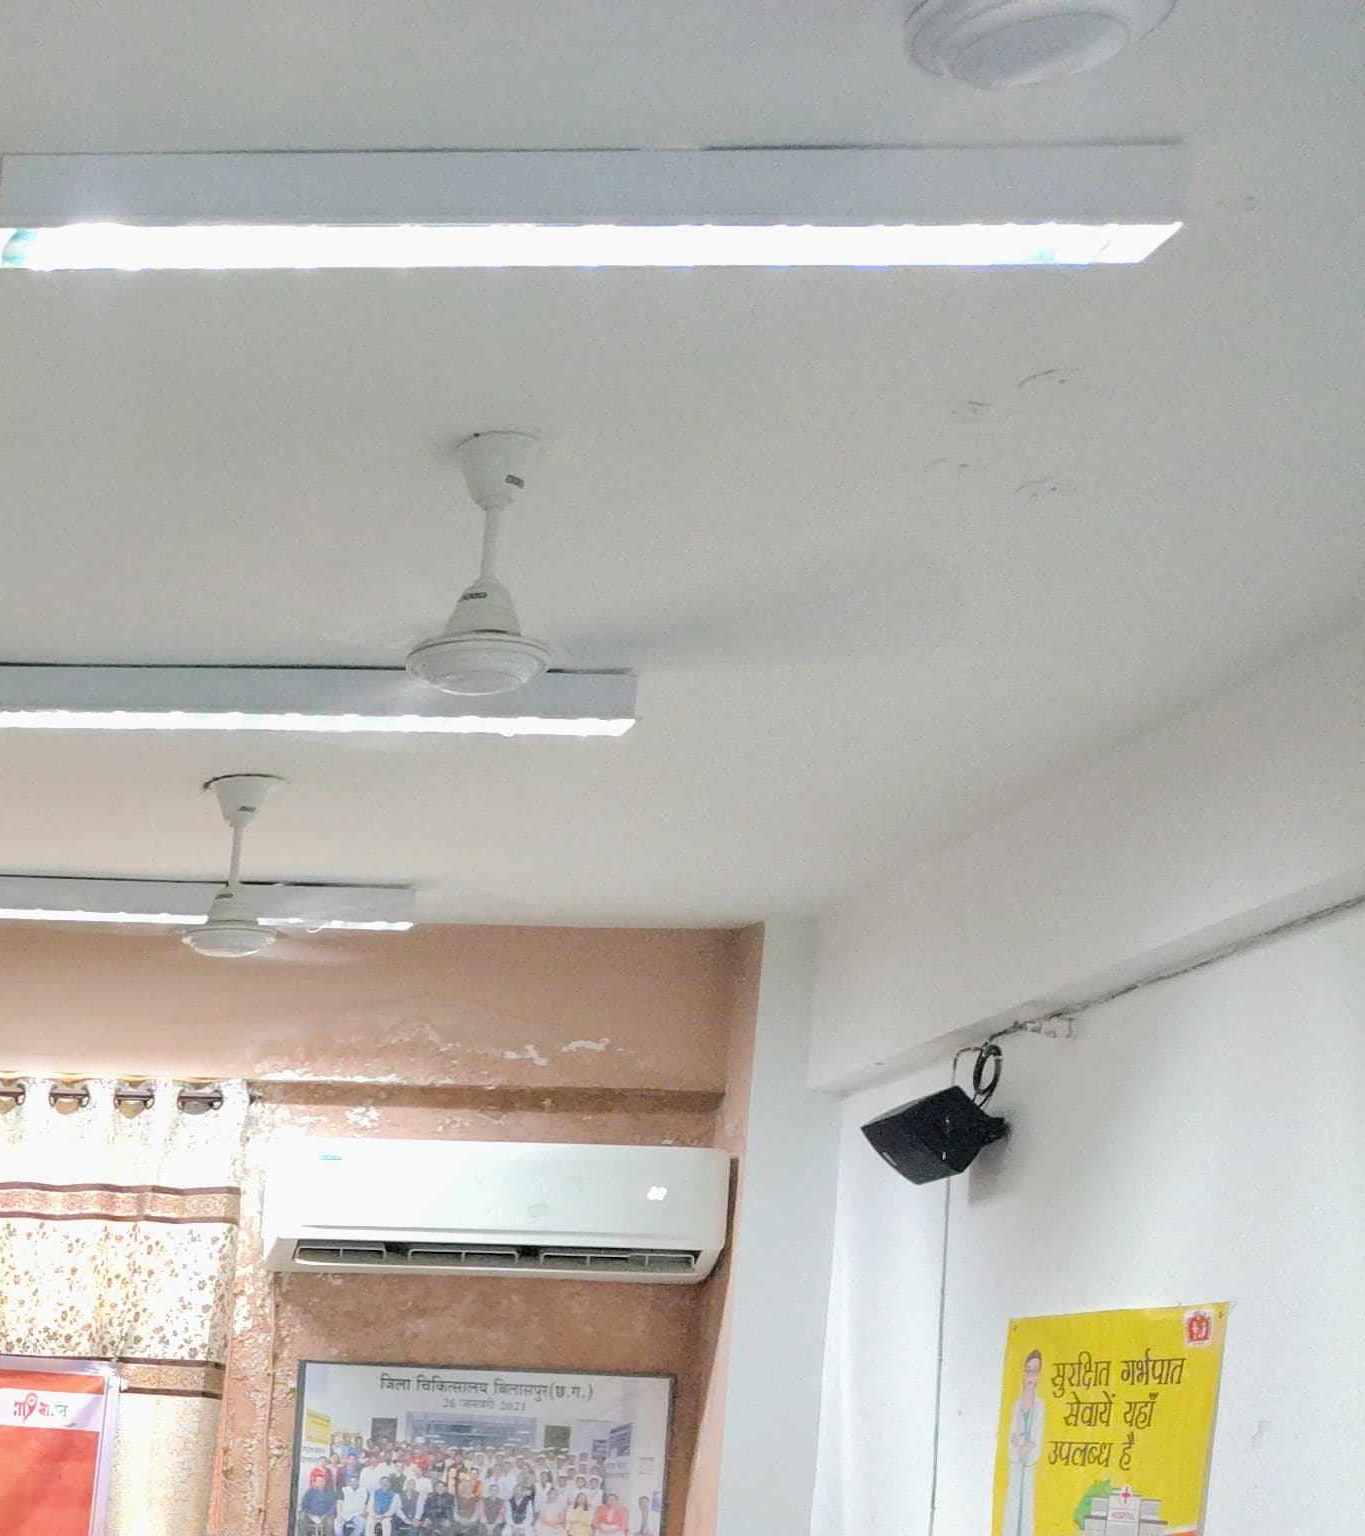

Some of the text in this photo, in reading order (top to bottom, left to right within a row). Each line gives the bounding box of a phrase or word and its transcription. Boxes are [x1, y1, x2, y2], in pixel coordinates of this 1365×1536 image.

[380, 1373, 411, 1391] जिला
[1051, 1347, 1187, 1398] सुरक्षित गर्भपात
[1063, 1390, 1159, 1430] सेवायें यहाँ
[1048, 1431, 1136, 1471] उपलब्ध है
